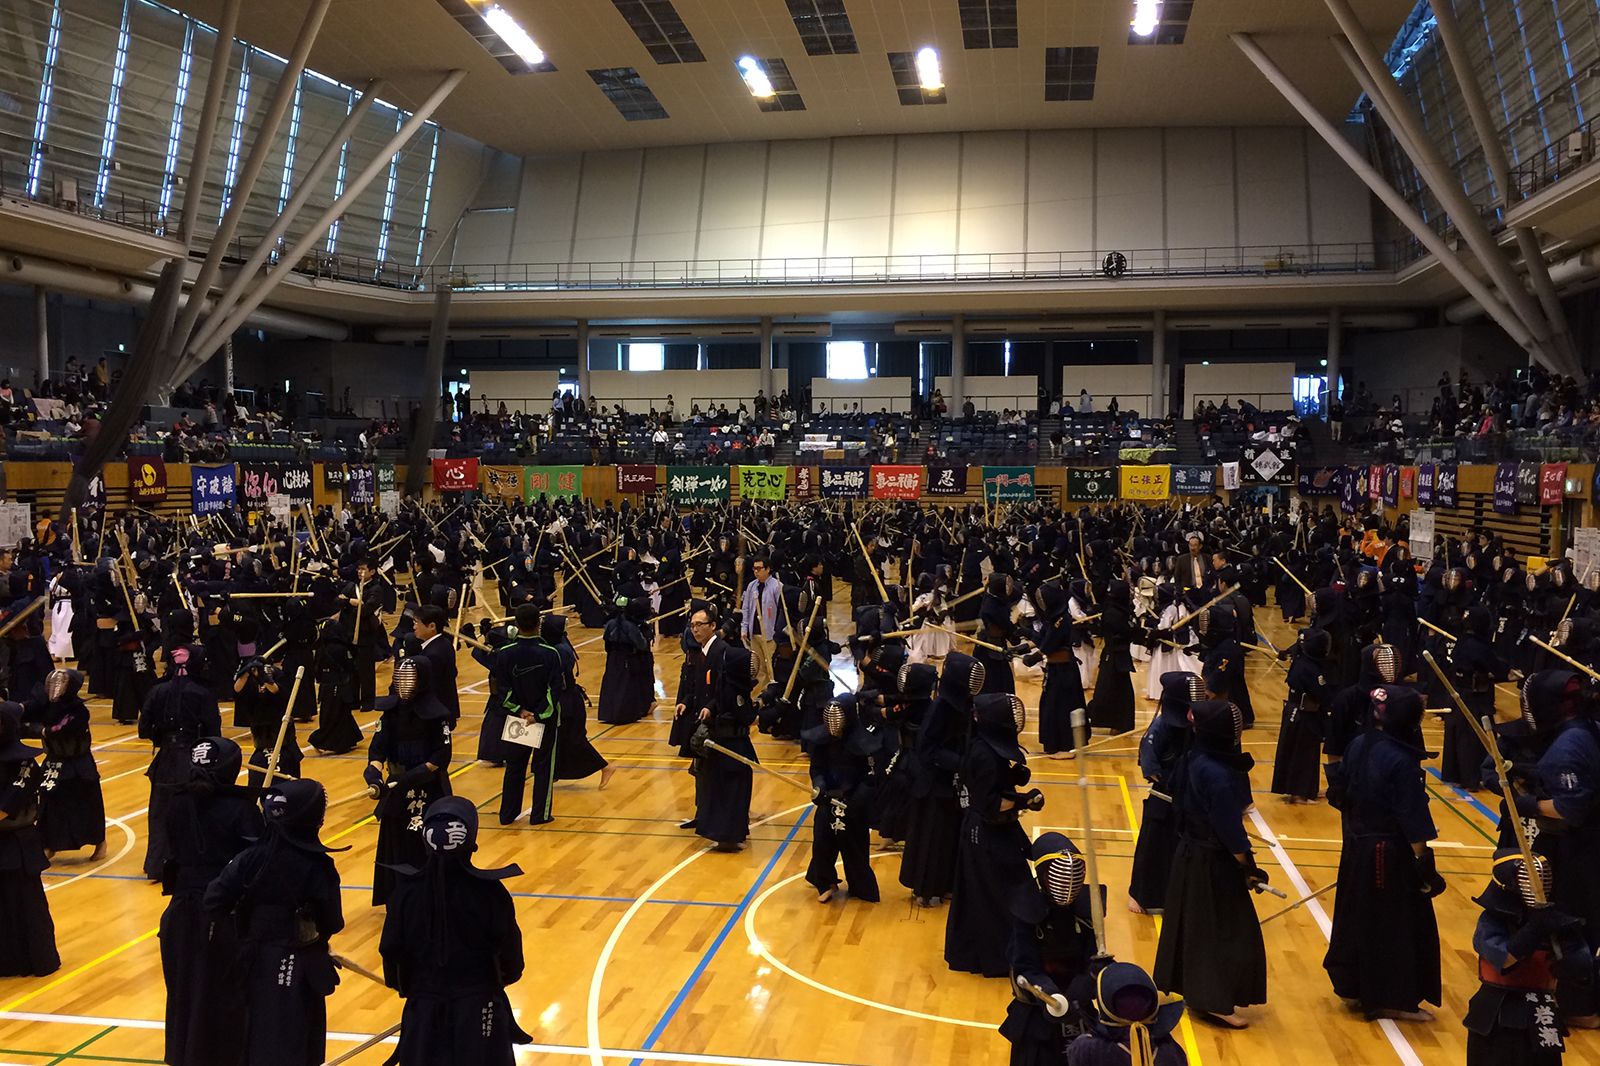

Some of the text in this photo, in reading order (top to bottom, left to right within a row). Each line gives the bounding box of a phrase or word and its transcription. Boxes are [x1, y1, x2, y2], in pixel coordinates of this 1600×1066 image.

[282, 469, 310, 489] 心技体
[444, 466, 463, 480] 心
[530, 472, 576, 492] 剛健
[743, 470, 782, 488] 克己心
[937, 469, 955, 487] 忍
[1533, 1004, 1563, 1048] 岩瀬
